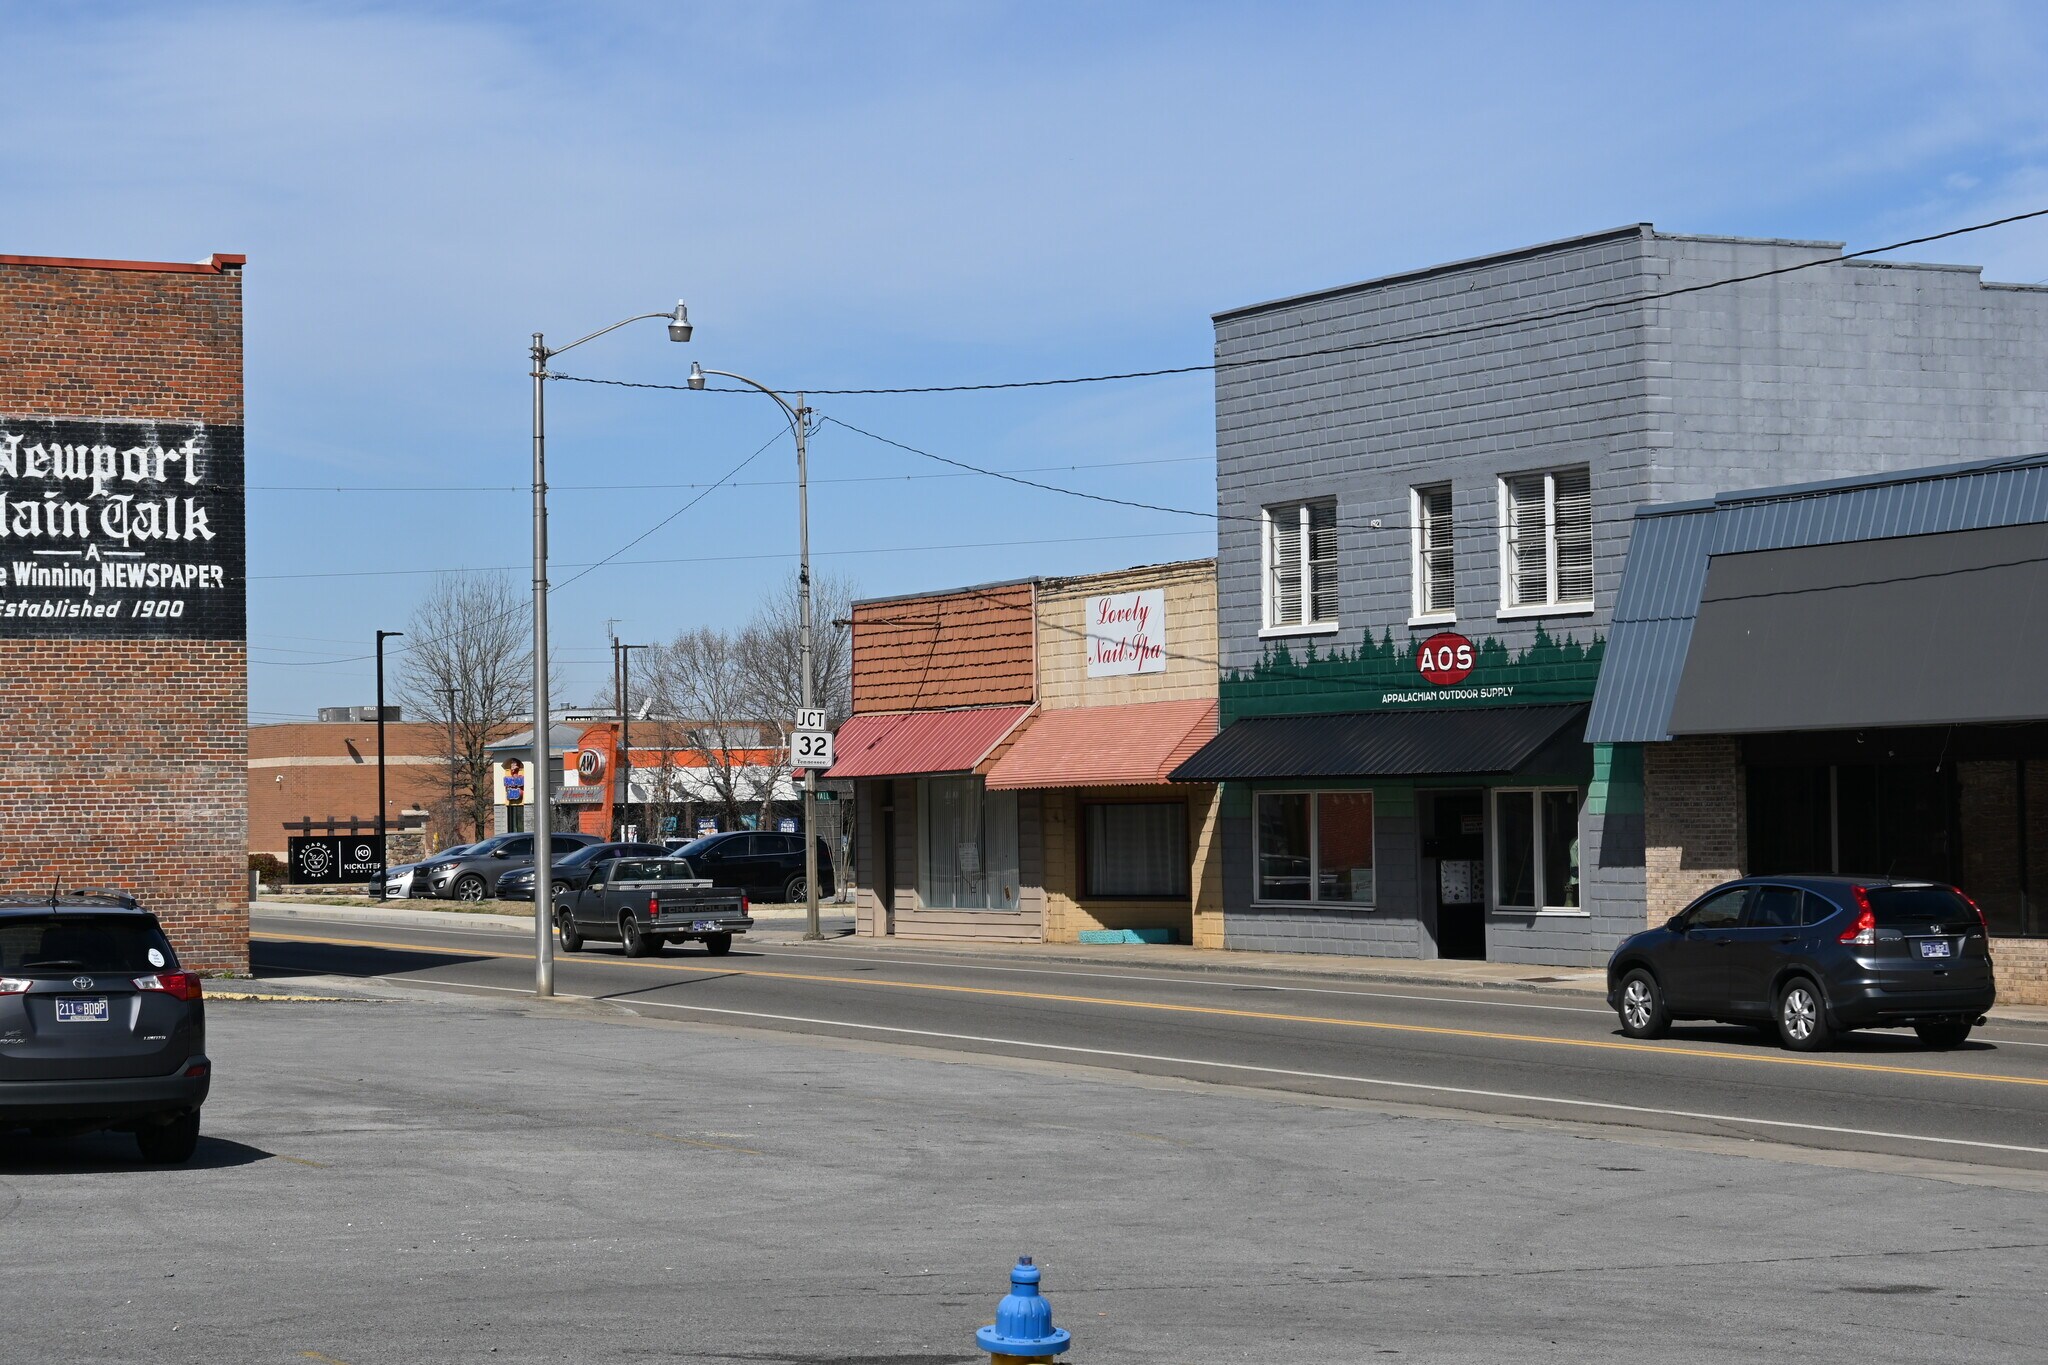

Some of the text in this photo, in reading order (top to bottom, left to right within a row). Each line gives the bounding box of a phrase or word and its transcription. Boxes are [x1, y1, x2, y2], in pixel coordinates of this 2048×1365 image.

[0, 434, 203, 499] Newport
[100, 494, 216, 547] Talk
[85, 543, 100, 561] A
[13, 562, 96, 596] Winning
[101, 563, 224, 588] NEWSPAPER
[131, 600, 185, 618] 1900
[1096, 596, 1152, 632] Lovely
[1088, 633, 1162, 671] Nail Spa
[1420, 645, 1473, 672] AOS
[1382, 686, 1514, 704] APPALACHIAN OUTDOOR SUPPLY
[798, 712, 824, 727] JCT
[799, 736, 827, 757] 32
[299, 842, 334, 859] BROADWAY
[357, 849, 369, 857] KD
[311, 869, 329, 877] MAIN
[668, 905, 731, 913] CHEVROLET
[59, 1002, 105, 1015] 211 BDBP
